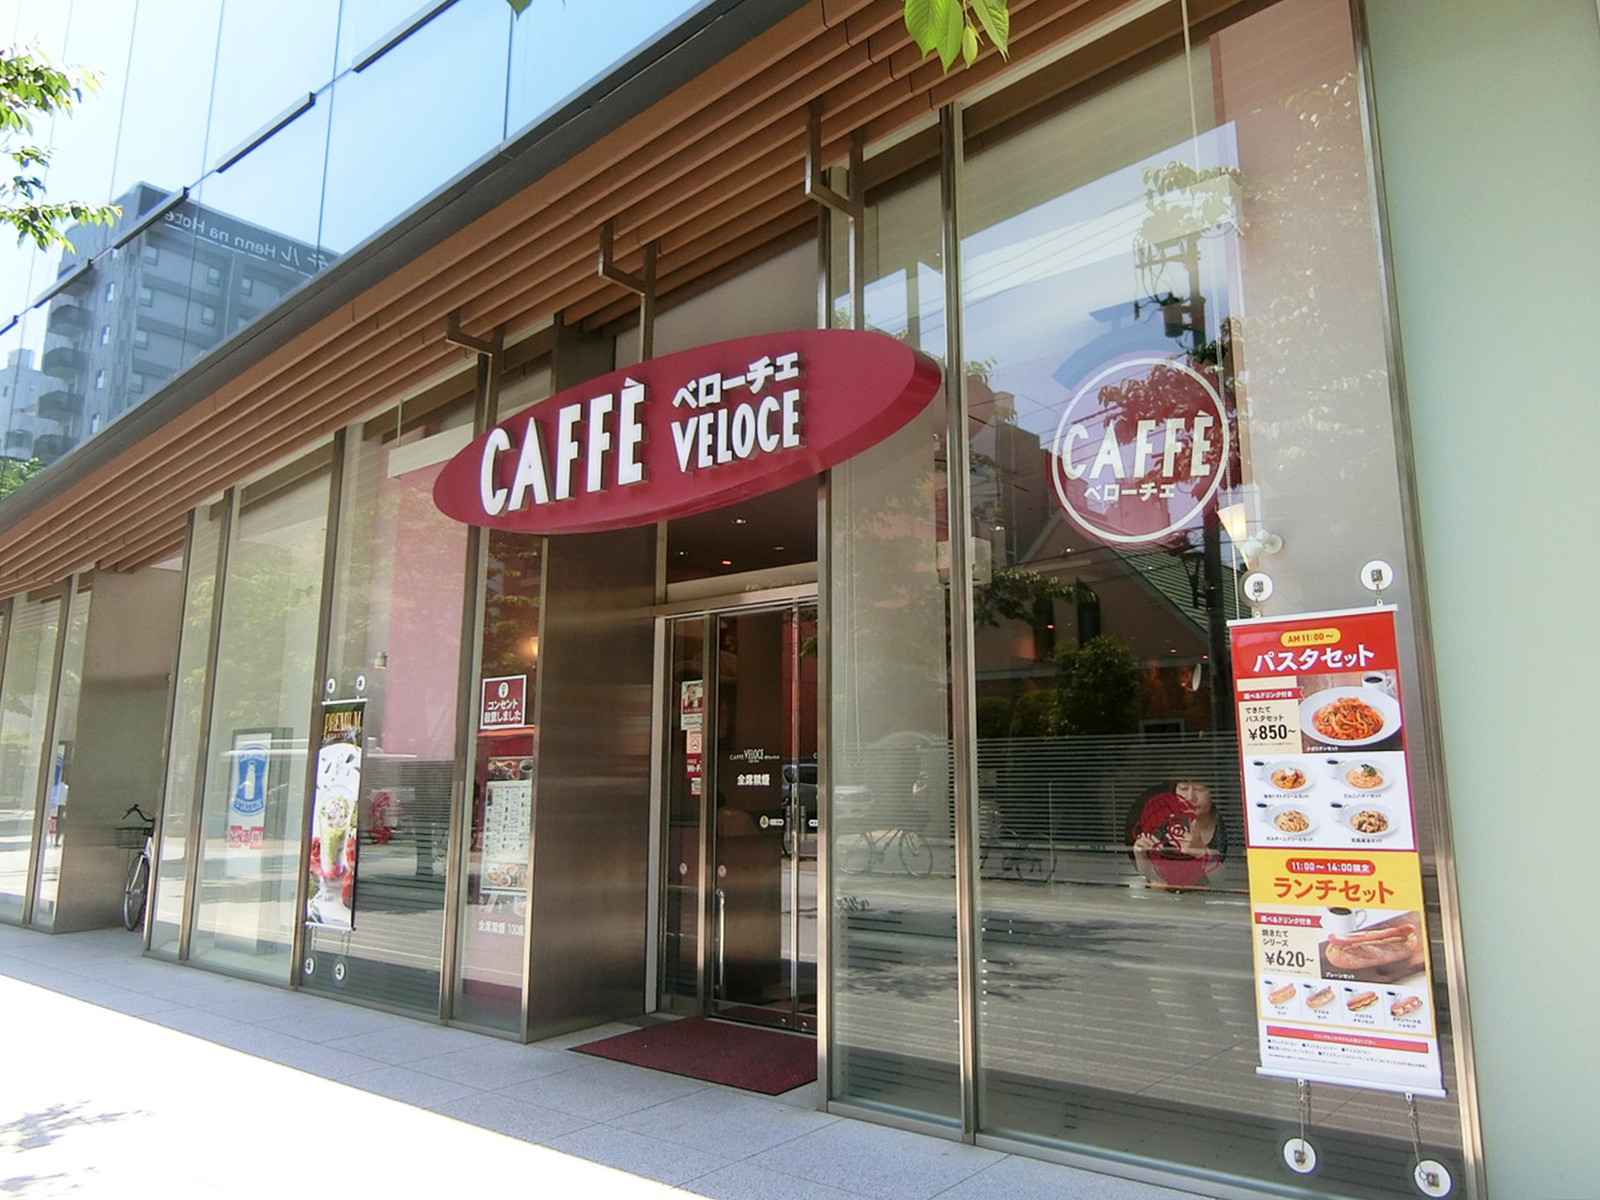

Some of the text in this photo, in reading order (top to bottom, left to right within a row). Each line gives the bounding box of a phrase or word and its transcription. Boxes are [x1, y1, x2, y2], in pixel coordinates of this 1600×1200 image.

[480, 377, 647, 517] CAFFÈ
[671, 388, 801, 473] VELOCE
[1062, 410, 1214, 480] CAFFÈ
[1254, 644, 1375, 672] パスタセット
[488, 699, 518, 710] コンセント
[1273, 877, 1395, 904] ランチセット
